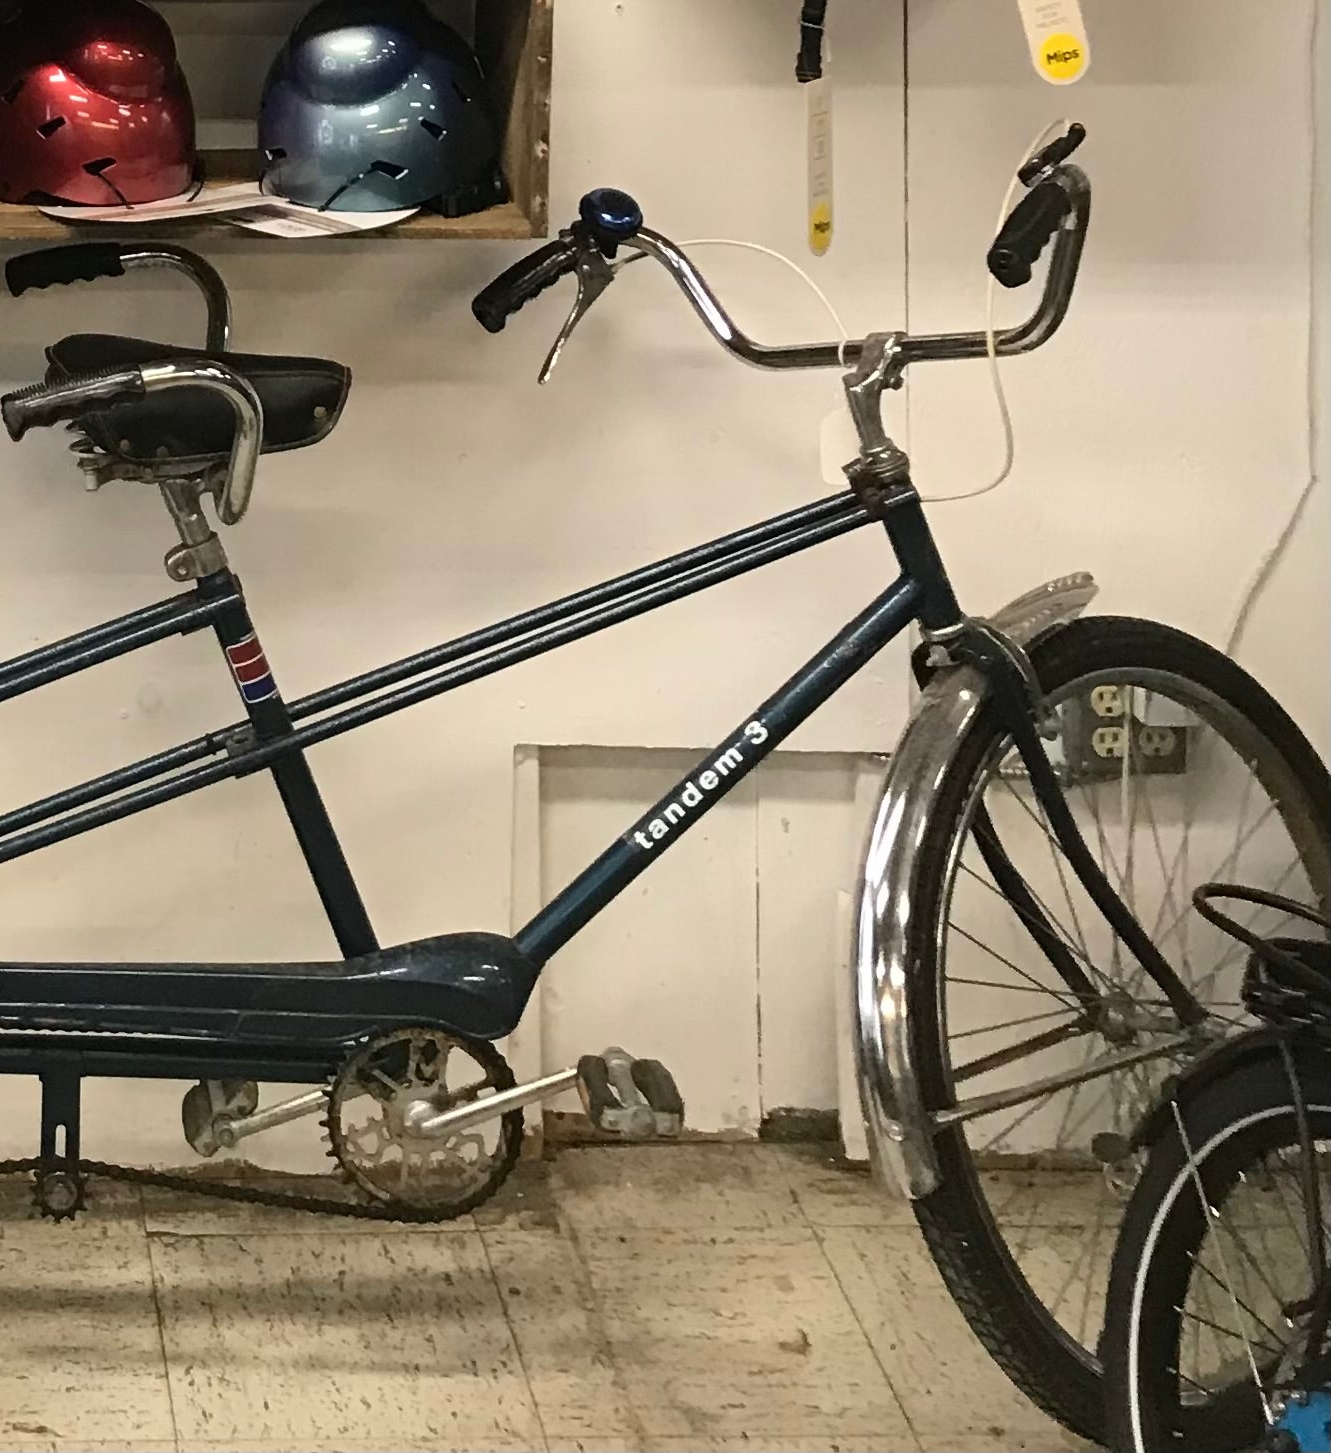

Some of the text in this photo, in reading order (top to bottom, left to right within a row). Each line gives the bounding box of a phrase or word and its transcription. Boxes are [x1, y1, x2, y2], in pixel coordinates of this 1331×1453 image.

[1046, 49, 1079, 65] Mips
[634, 720, 769, 849] tandem 3
